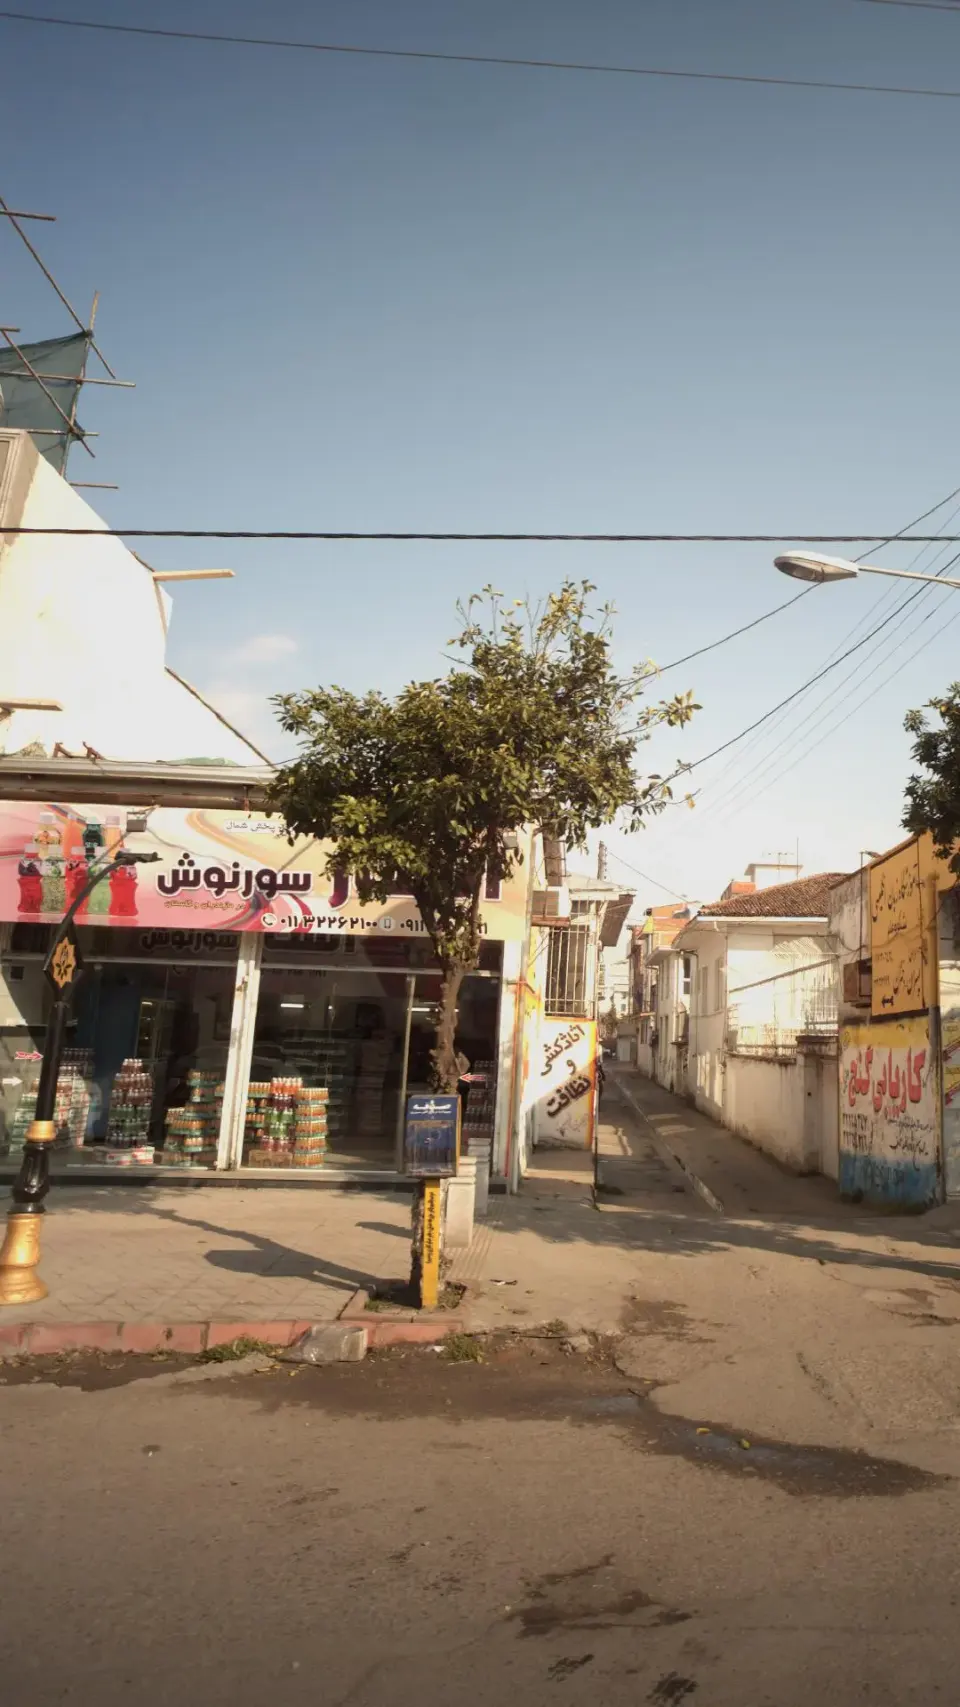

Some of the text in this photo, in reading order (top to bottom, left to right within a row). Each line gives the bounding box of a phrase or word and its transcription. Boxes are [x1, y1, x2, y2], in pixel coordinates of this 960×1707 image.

[226, 820, 249, 831] شمال
[157, 852, 312, 899] سورنوش
[566, 1059, 577, 1076] و
[872, 1045, 927, 1114] کاریابی
[546, 1075, 592, 1118] نظافت
